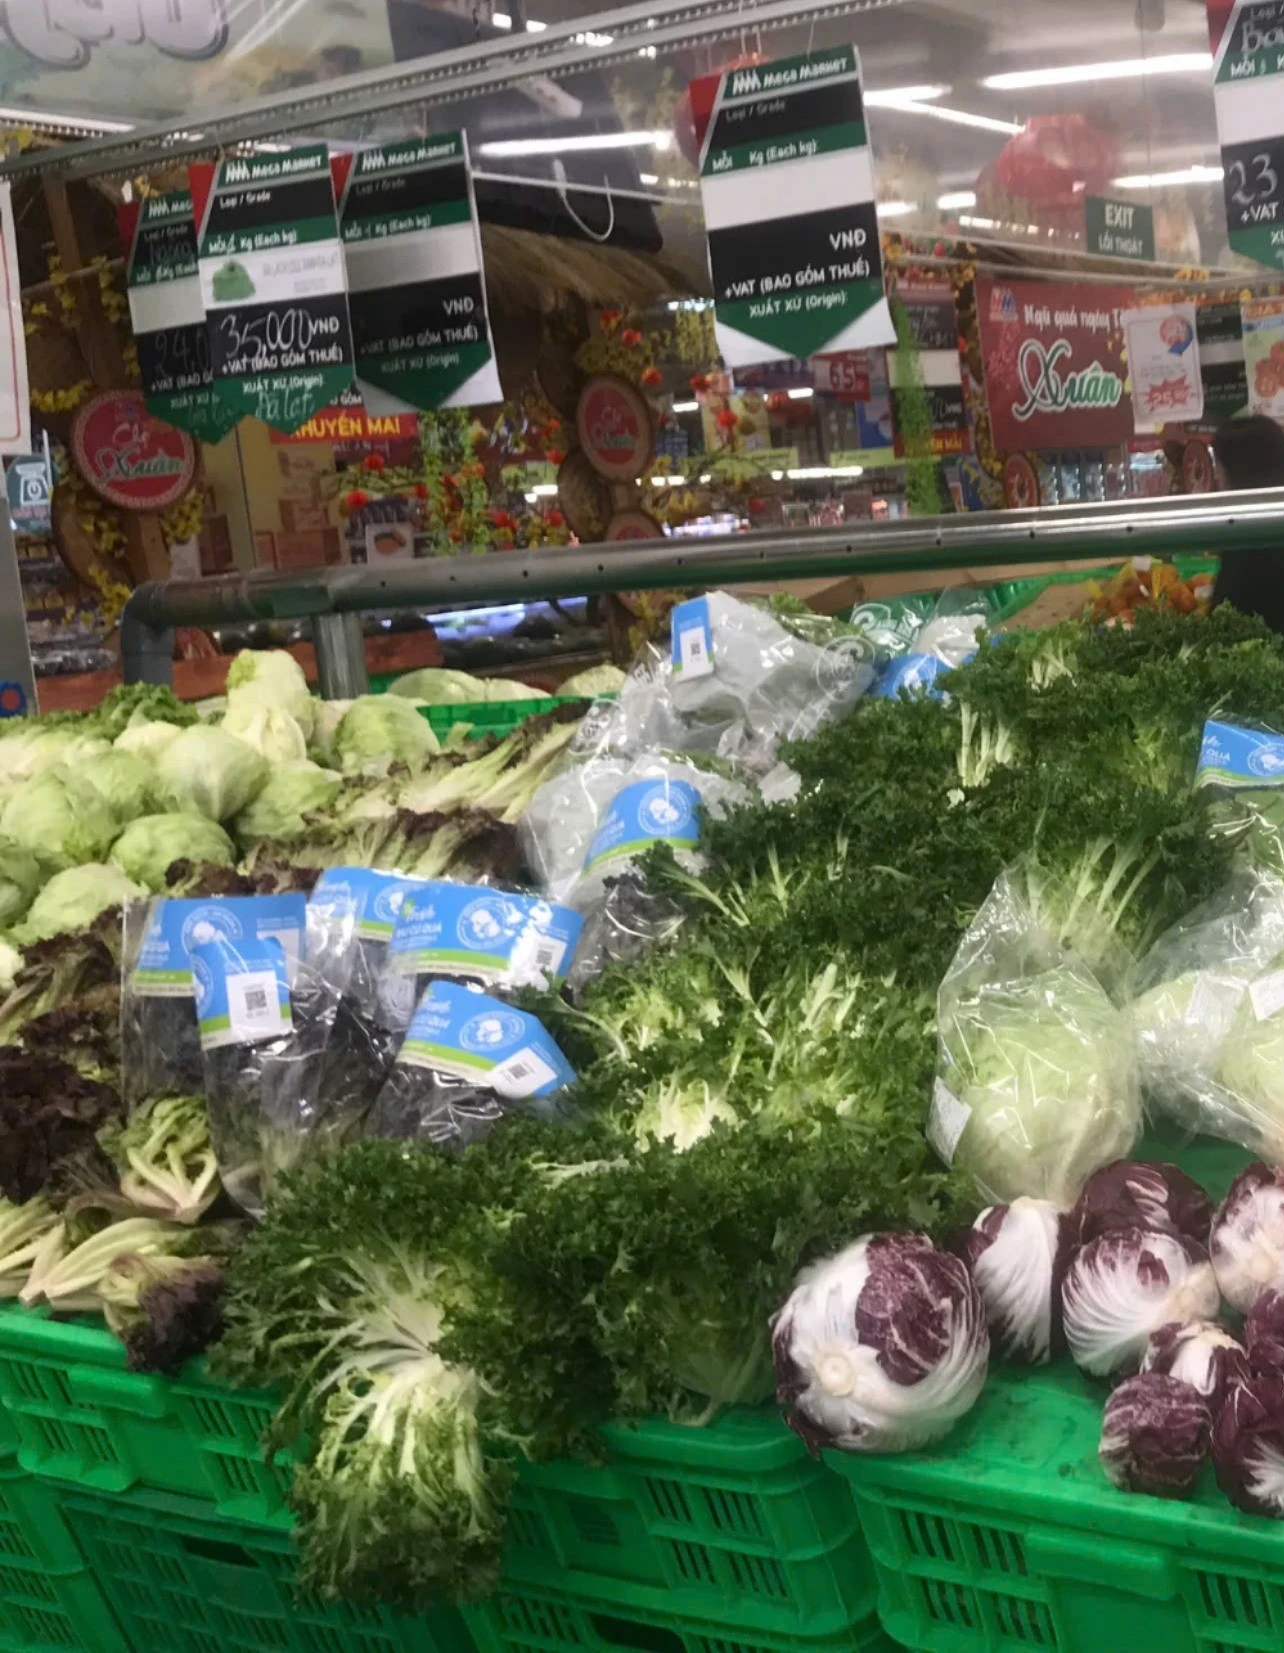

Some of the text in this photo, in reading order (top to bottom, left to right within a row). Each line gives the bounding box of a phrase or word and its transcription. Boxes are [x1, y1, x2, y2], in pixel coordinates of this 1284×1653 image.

[1105, 203, 1134, 230] EXIT
[829, 229, 867, 250] VNĐ
[310, 316, 339, 334] VNĐ
[1012, 338, 1123, 422] Xuân
